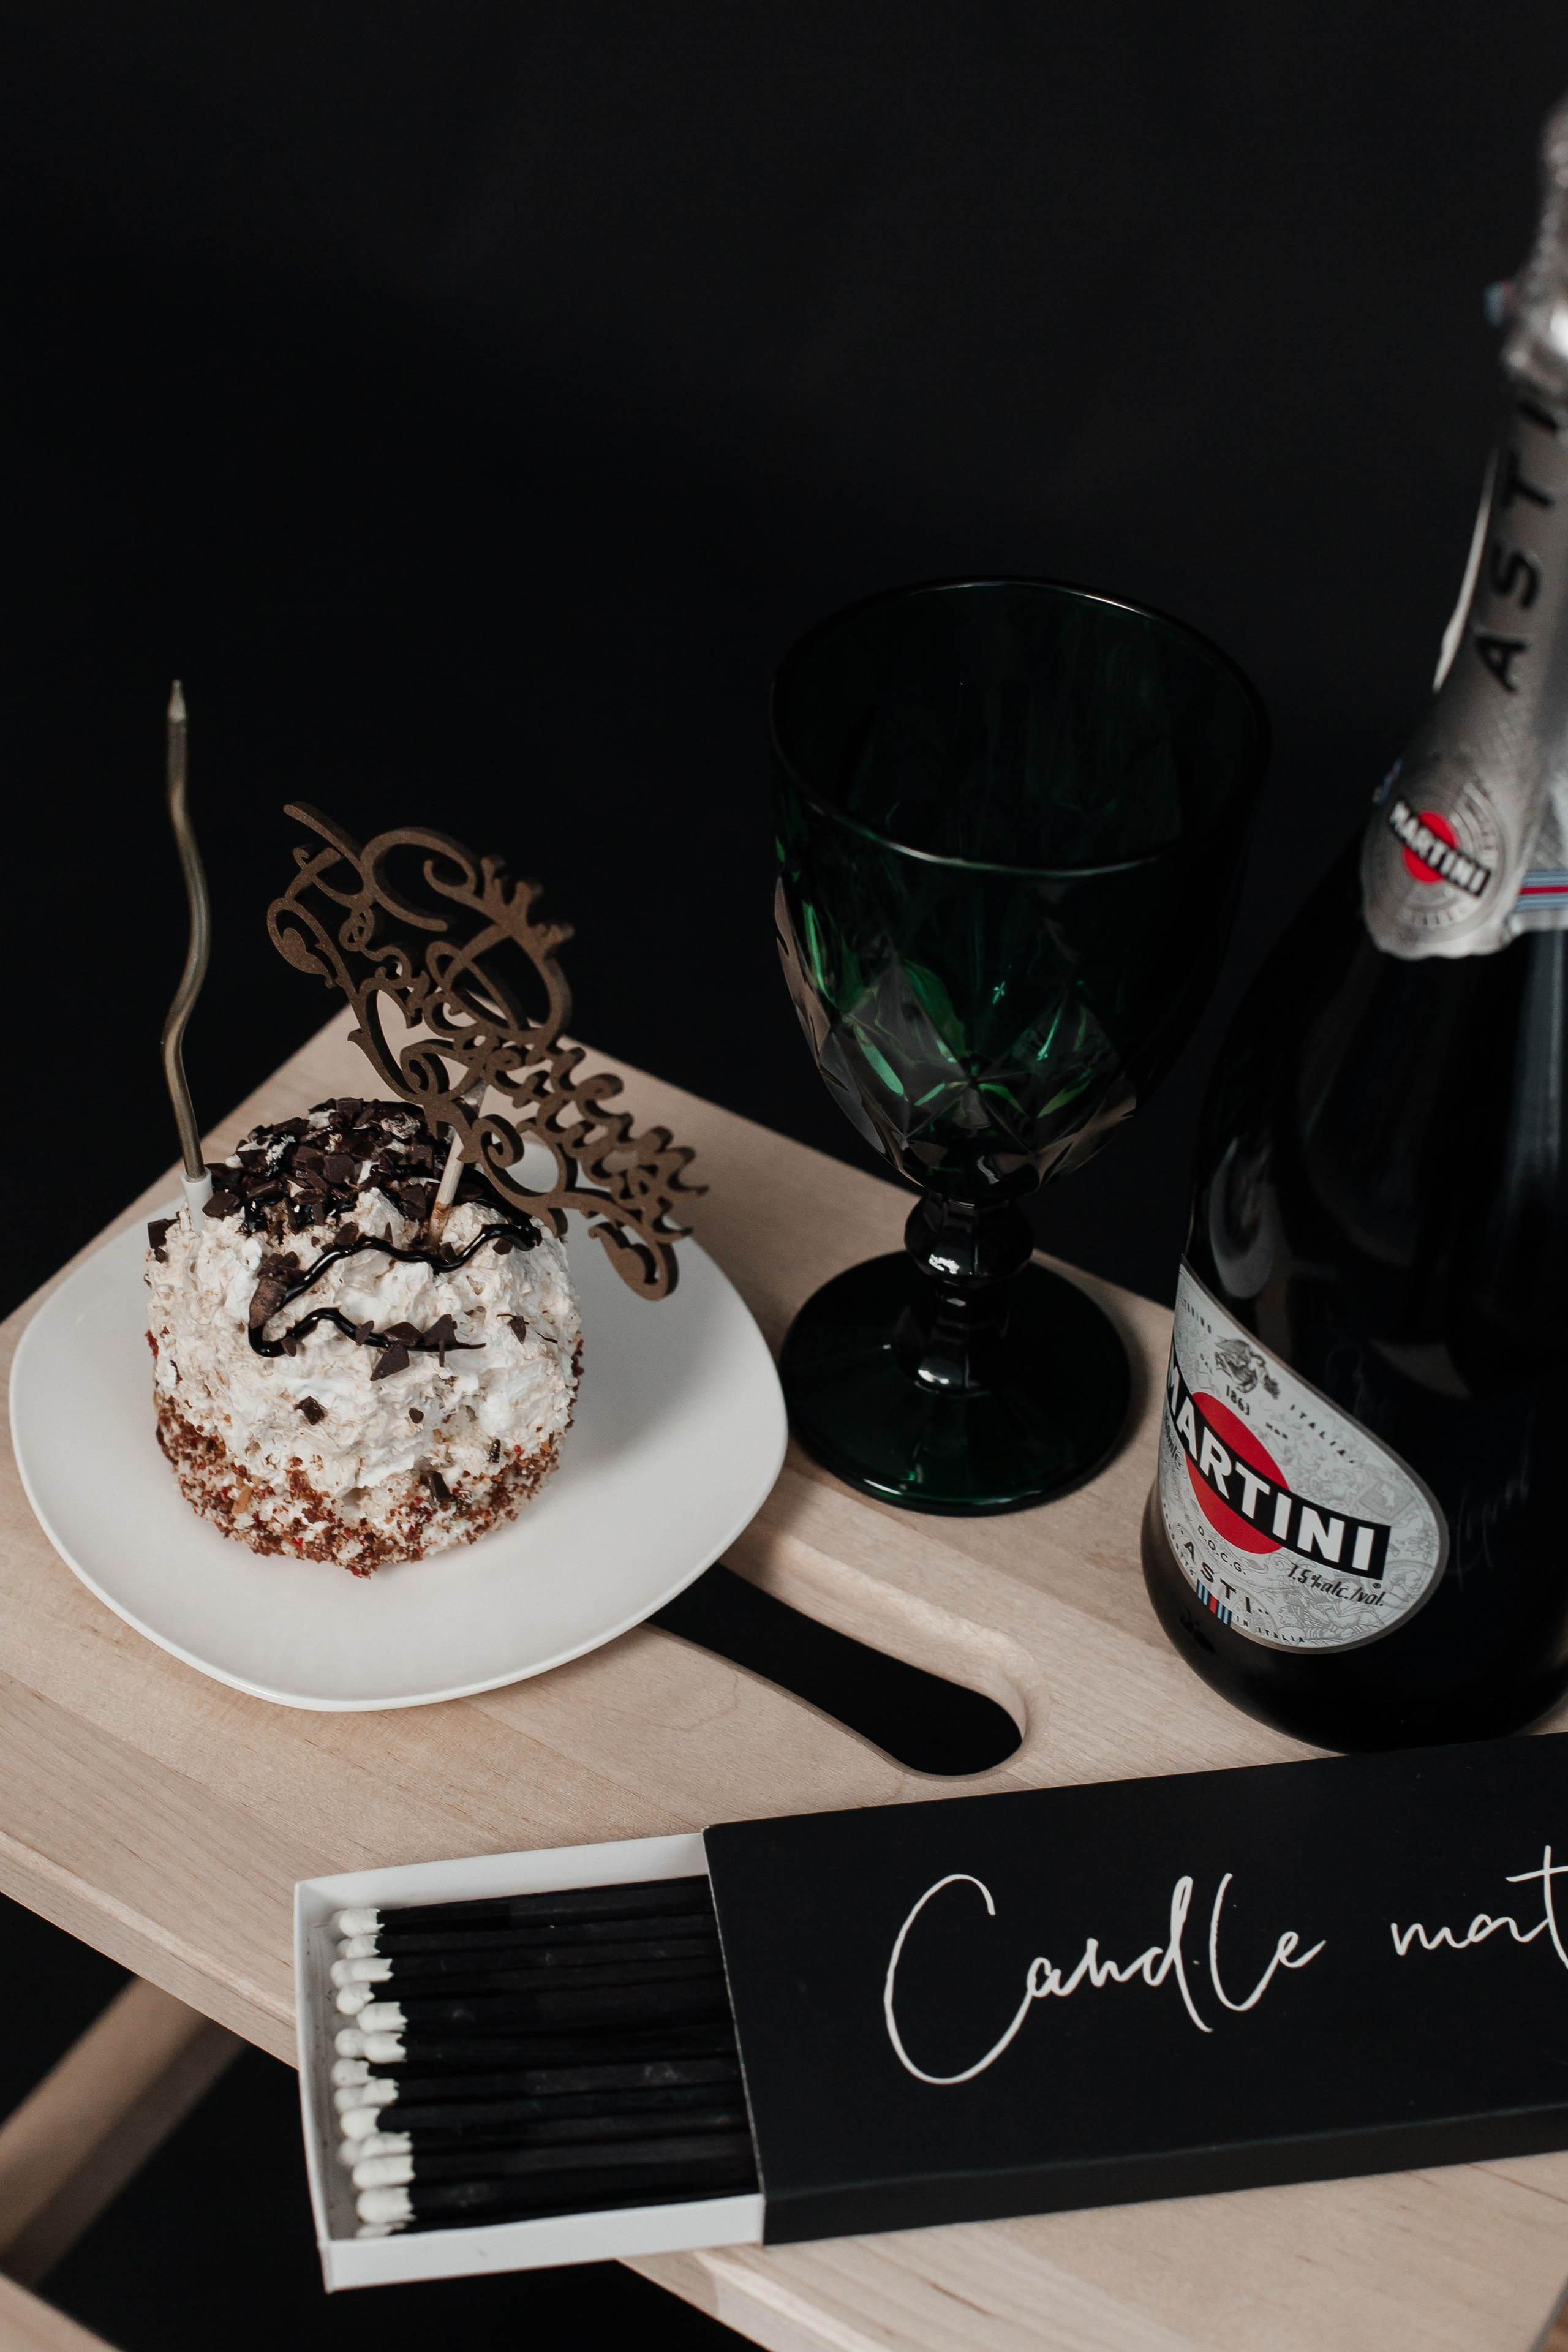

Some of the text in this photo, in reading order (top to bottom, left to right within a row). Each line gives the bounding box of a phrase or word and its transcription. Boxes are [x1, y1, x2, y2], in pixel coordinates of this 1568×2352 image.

[1475, 401, 1559, 695] ASTI
[1389, 799, 1488, 894] MARTINI
[1225, 1384, 1250, 1416] 1863
[1167, 1346, 1375, 1572] MARTINI
[1183, 1539, 1253, 1615] ASTI
[1197, 1524, 1248, 1576] D.O.C.G.
[1257, 1626, 1305, 1643] ITALIA
[884, 1873, 1325, 2084] Candle
